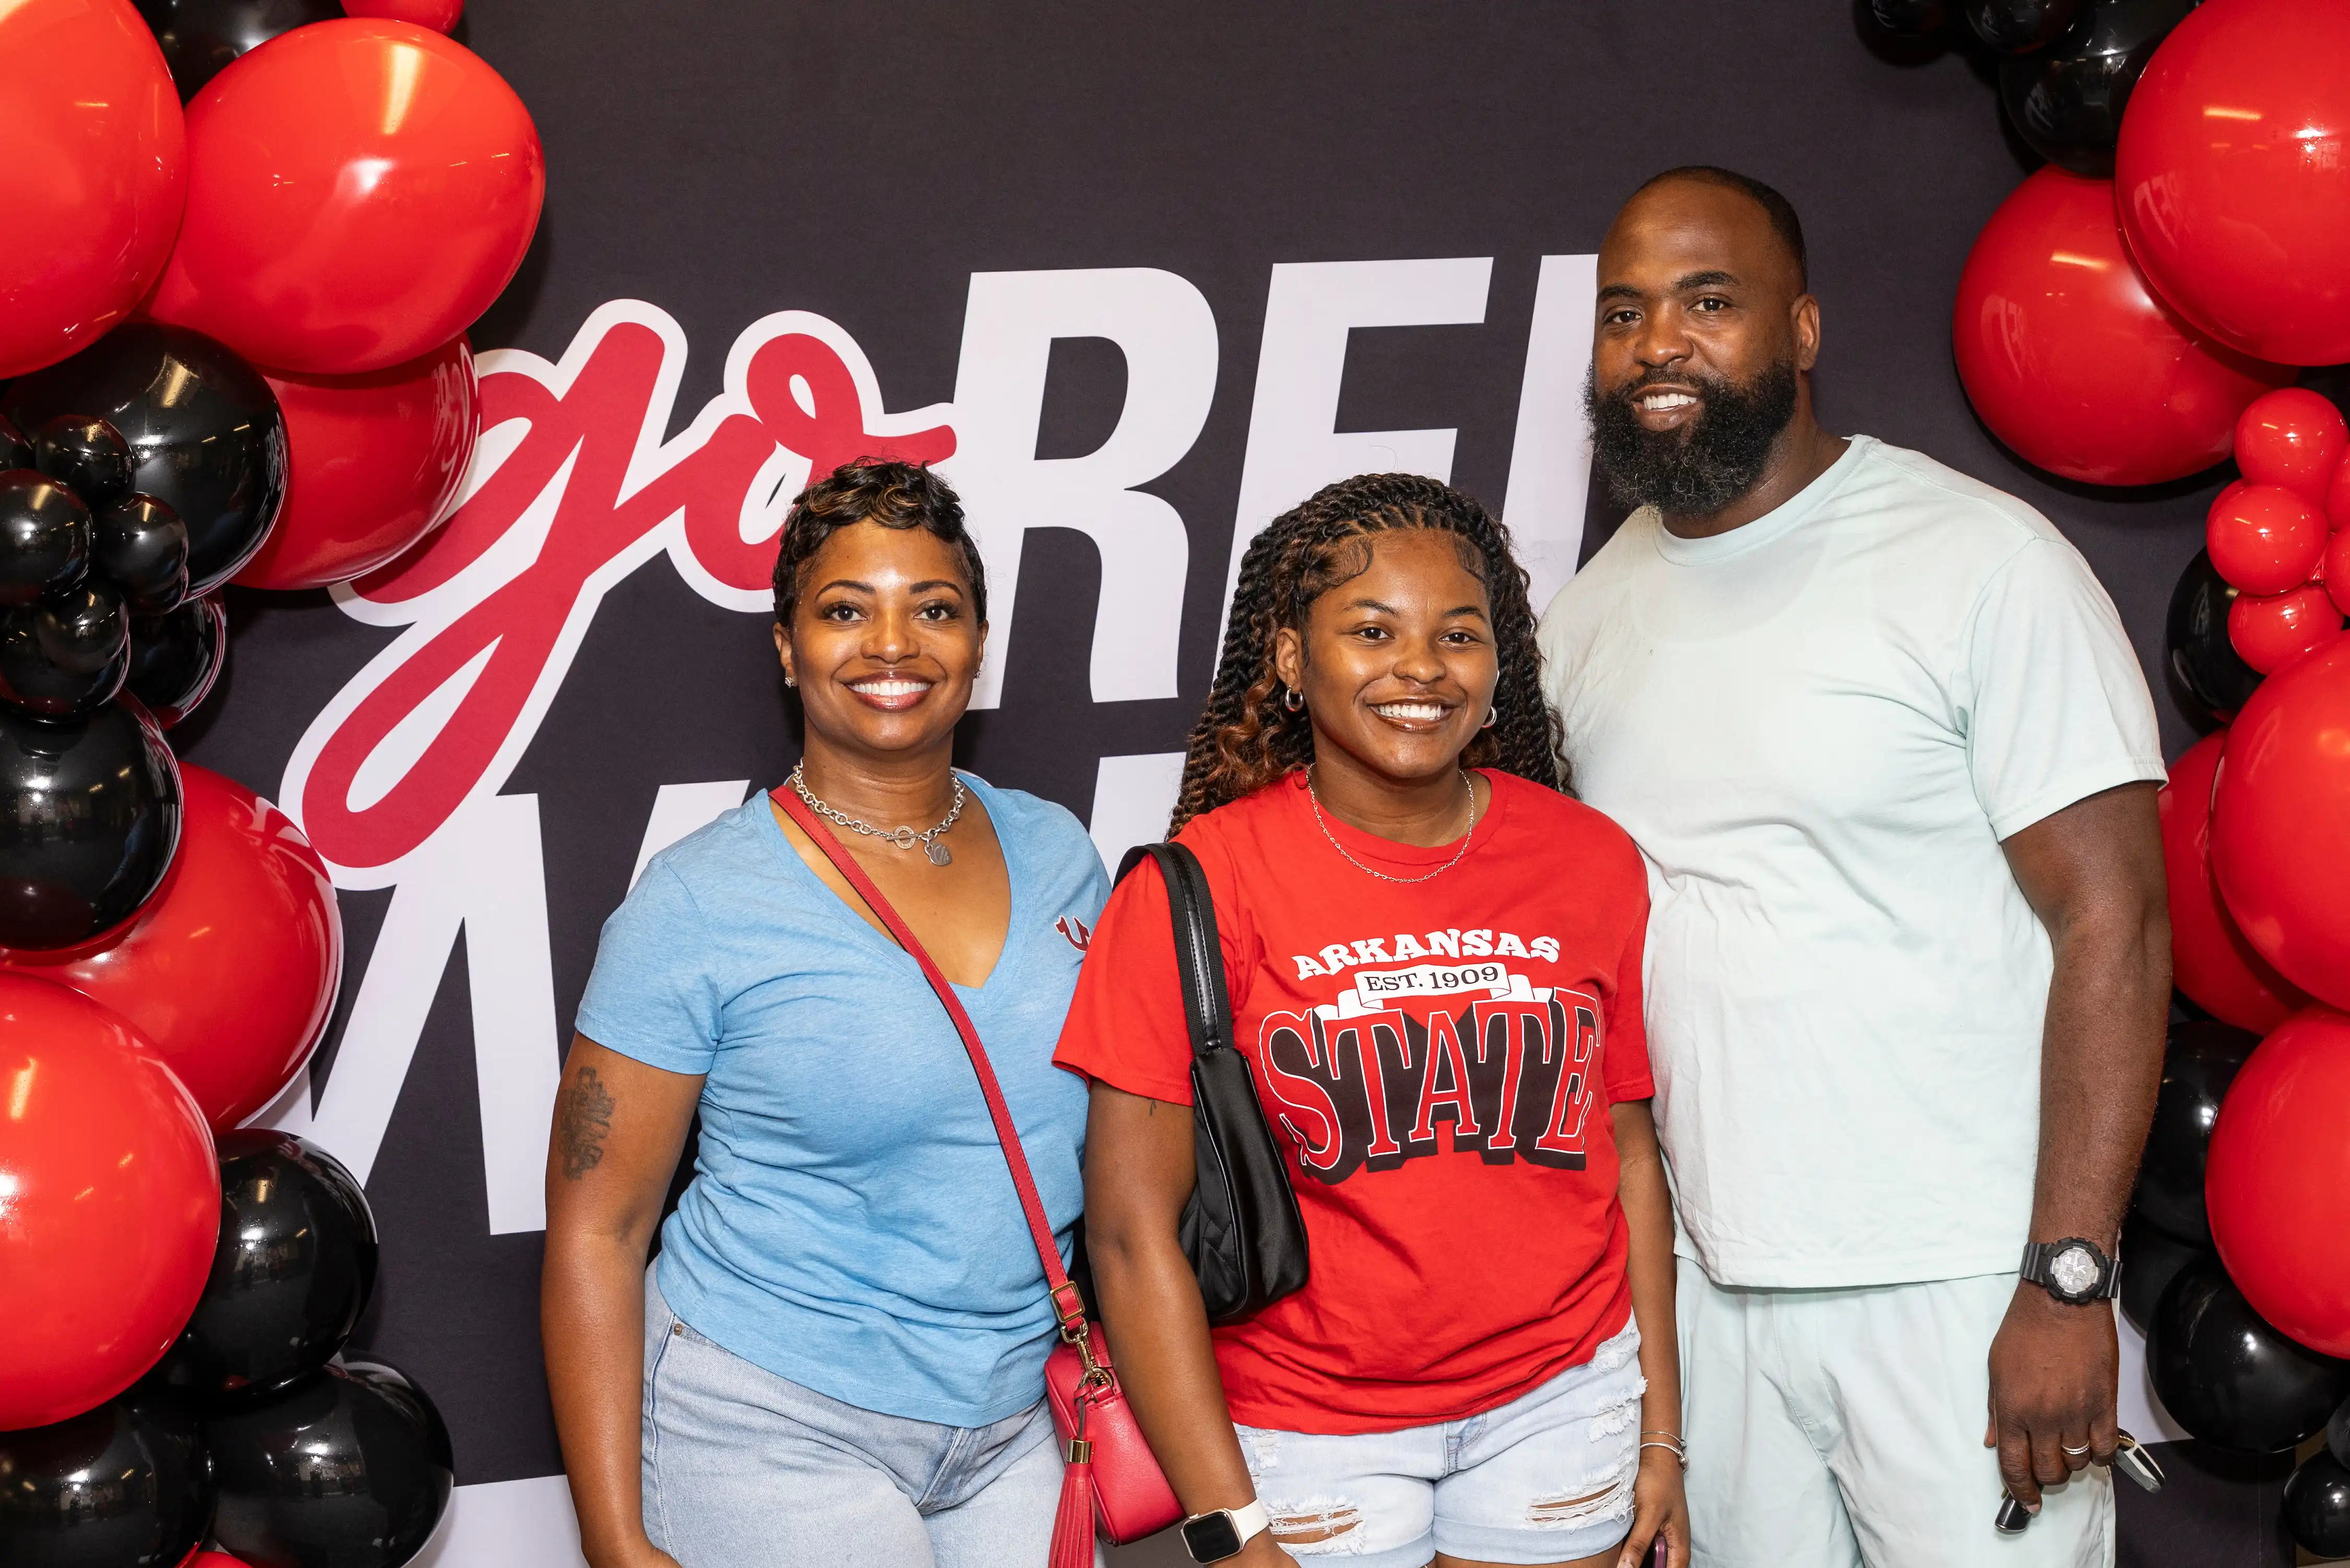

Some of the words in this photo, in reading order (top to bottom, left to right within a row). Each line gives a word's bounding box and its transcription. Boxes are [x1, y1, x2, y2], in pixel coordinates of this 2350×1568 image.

[300, 319, 958, 870] go
[1291, 928, 1561, 981] ARKANSAS
[1364, 972, 1424, 991] EST.
[1429, 966, 1498, 989] 1909
[1258, 986, 1601, 1171] STATE
